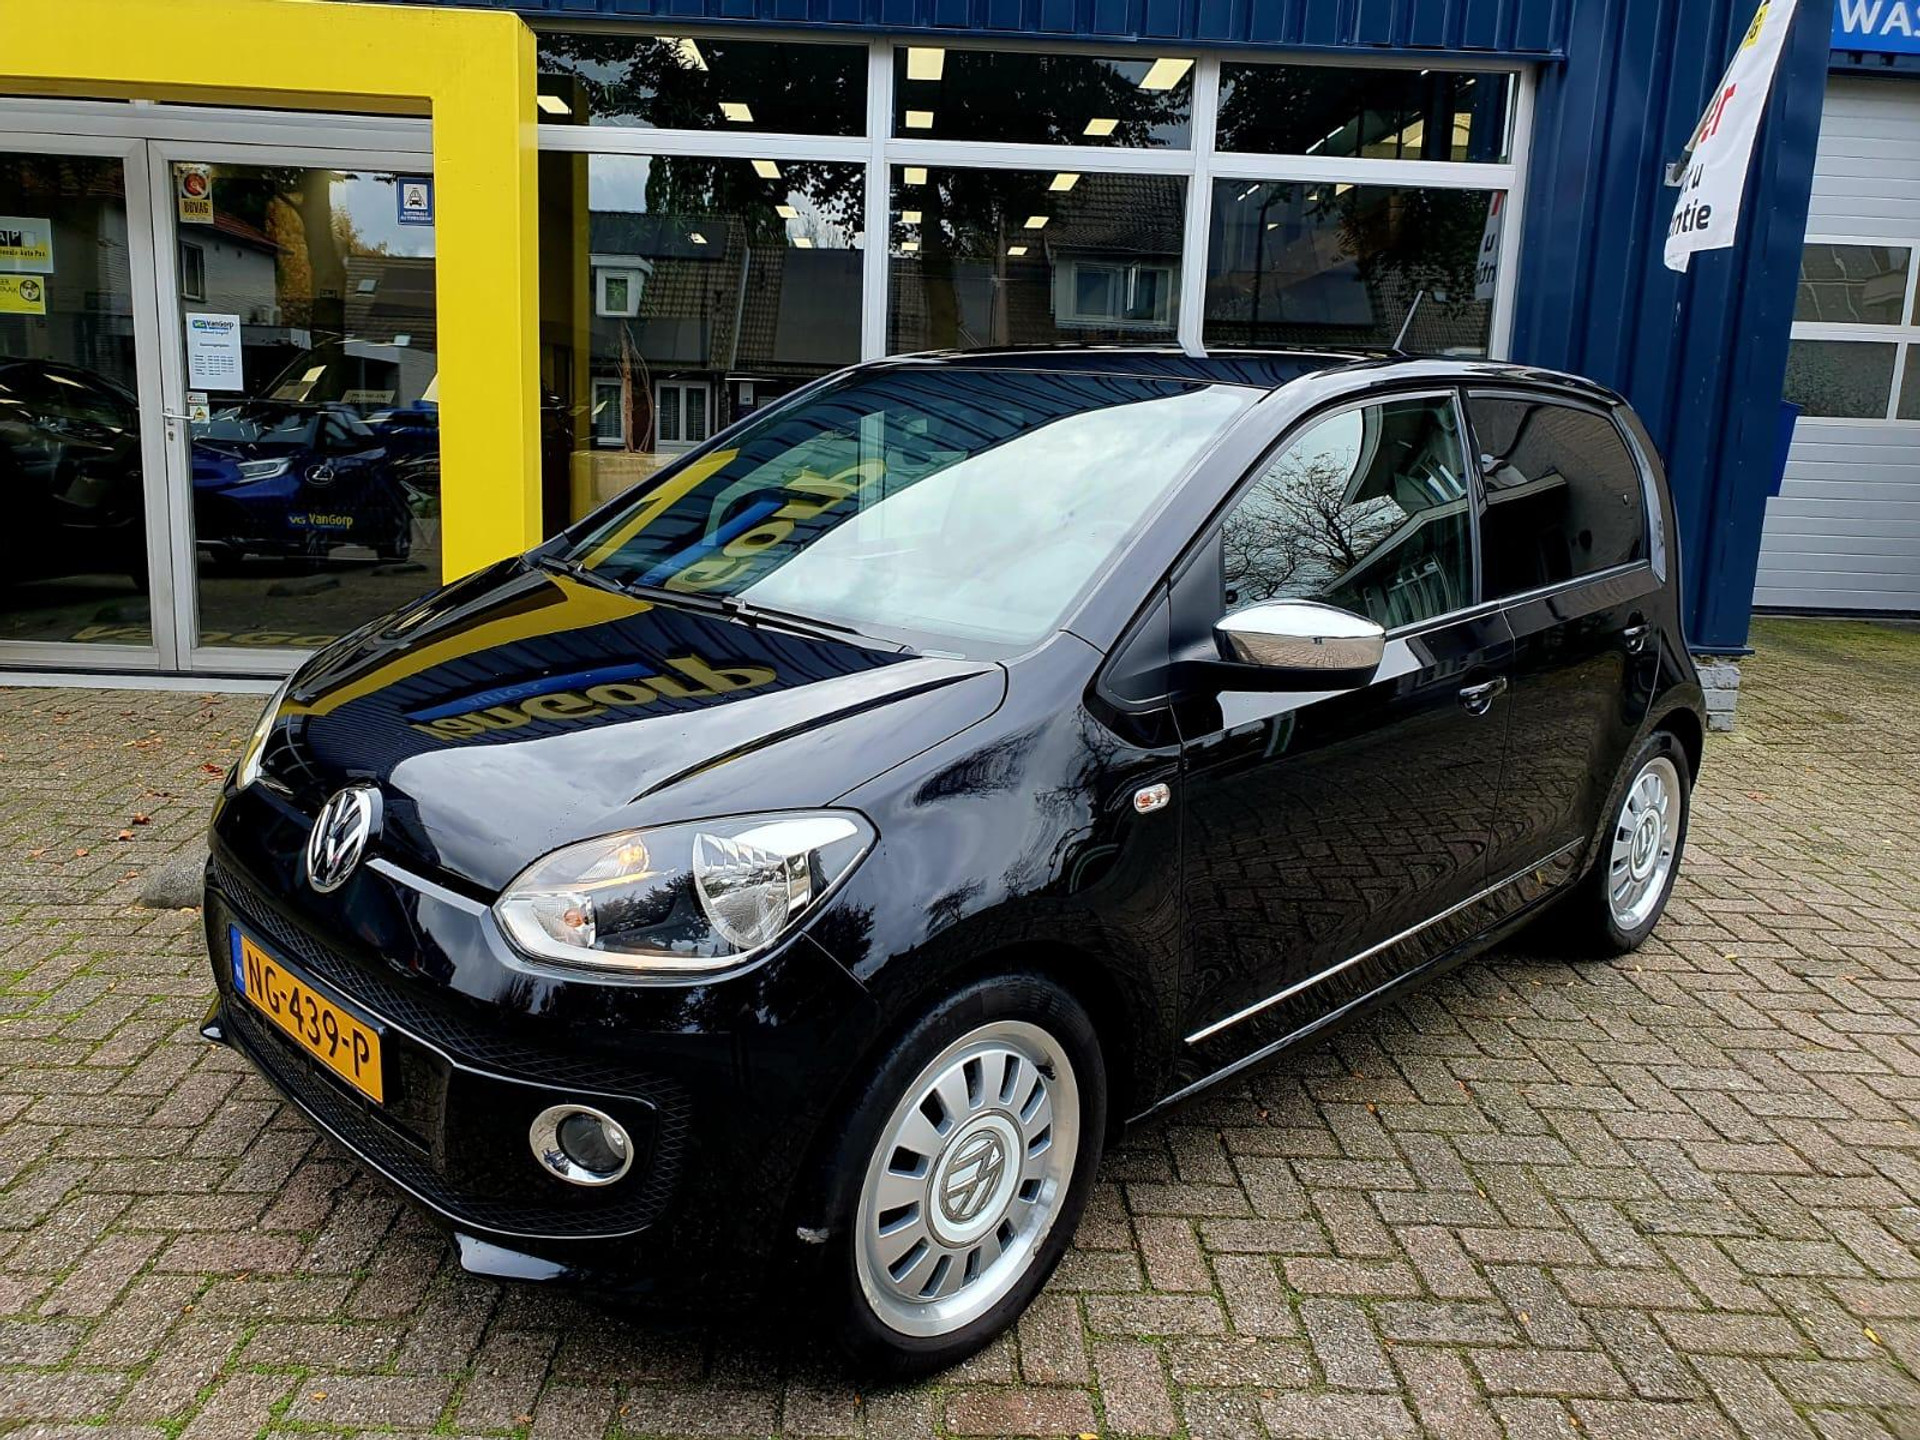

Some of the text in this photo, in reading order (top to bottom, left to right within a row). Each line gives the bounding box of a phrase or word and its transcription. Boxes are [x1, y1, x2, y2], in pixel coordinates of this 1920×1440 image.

[207, 320, 234, 331] VanGorp
[309, 513, 353, 529] VanGorp
[247, 949, 370, 1078] NG-439-P
